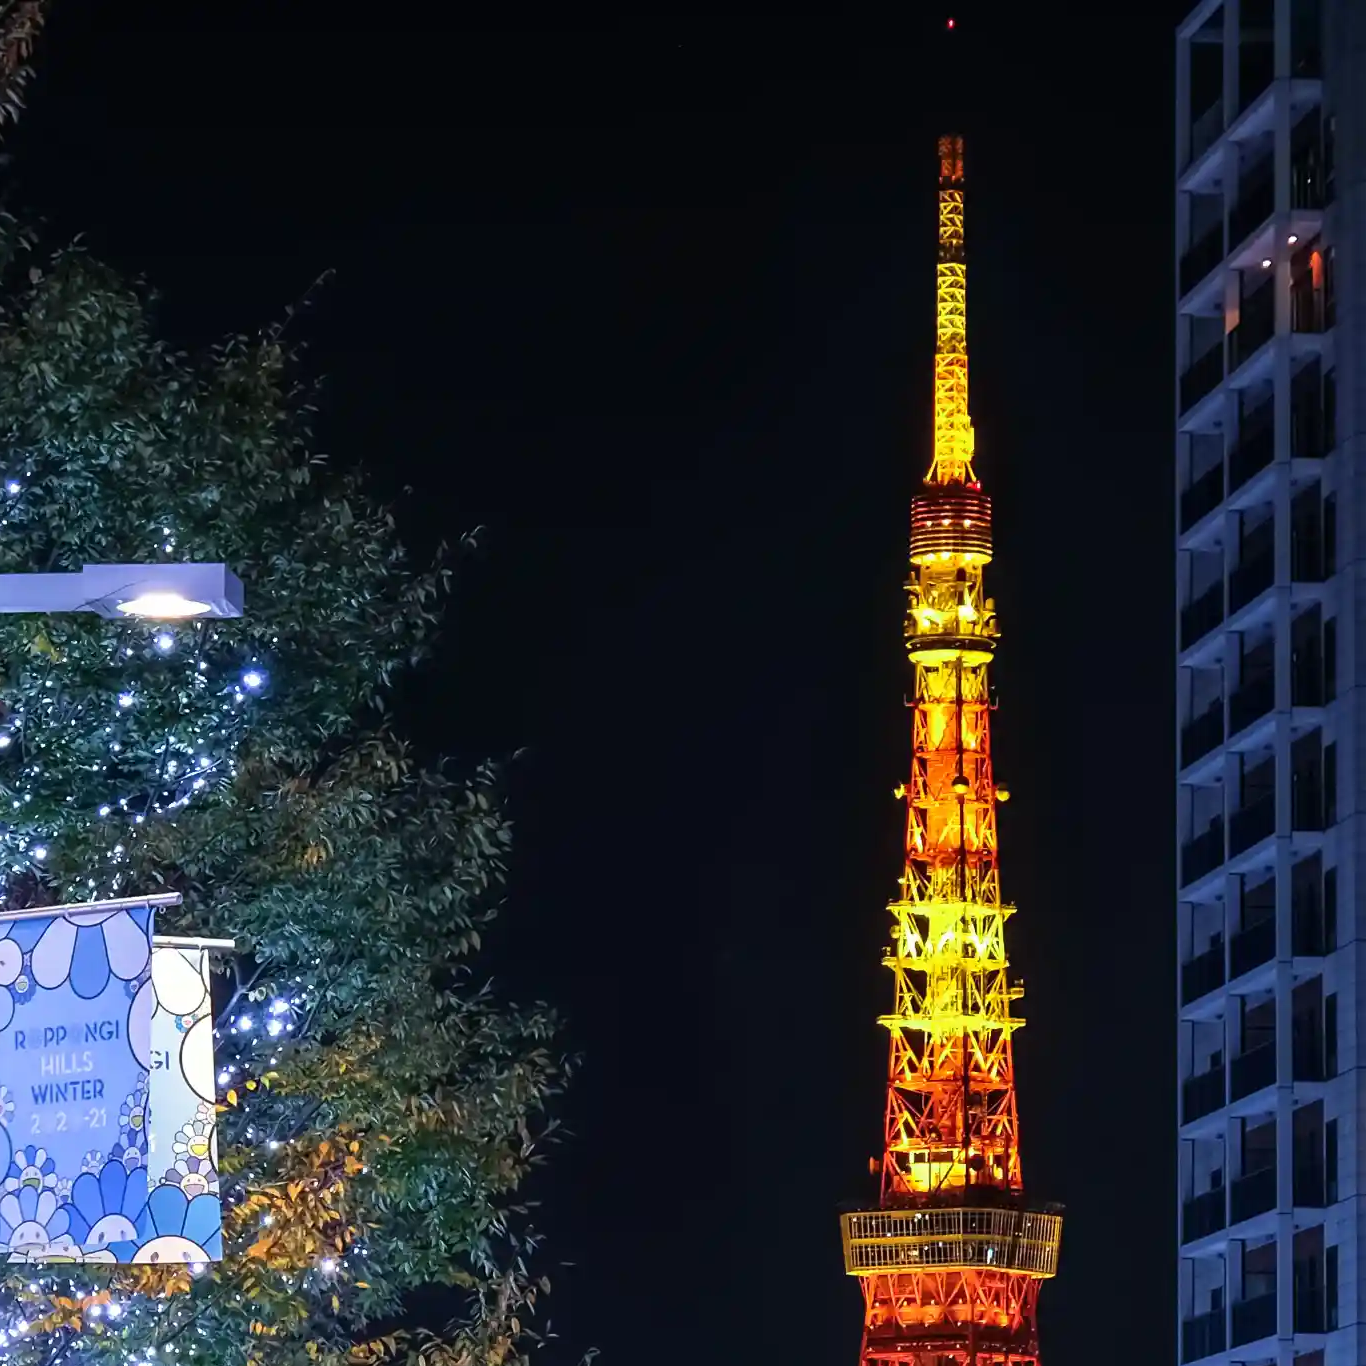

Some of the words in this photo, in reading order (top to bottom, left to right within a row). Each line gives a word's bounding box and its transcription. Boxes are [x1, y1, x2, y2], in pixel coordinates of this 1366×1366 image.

[15, 1020, 119, 1050] RPPNGI
[41, 1051, 94, 1076] HILLS
[31, 1079, 105, 1105] WINTER
[31, 1107, 107, 1134] 22-21
